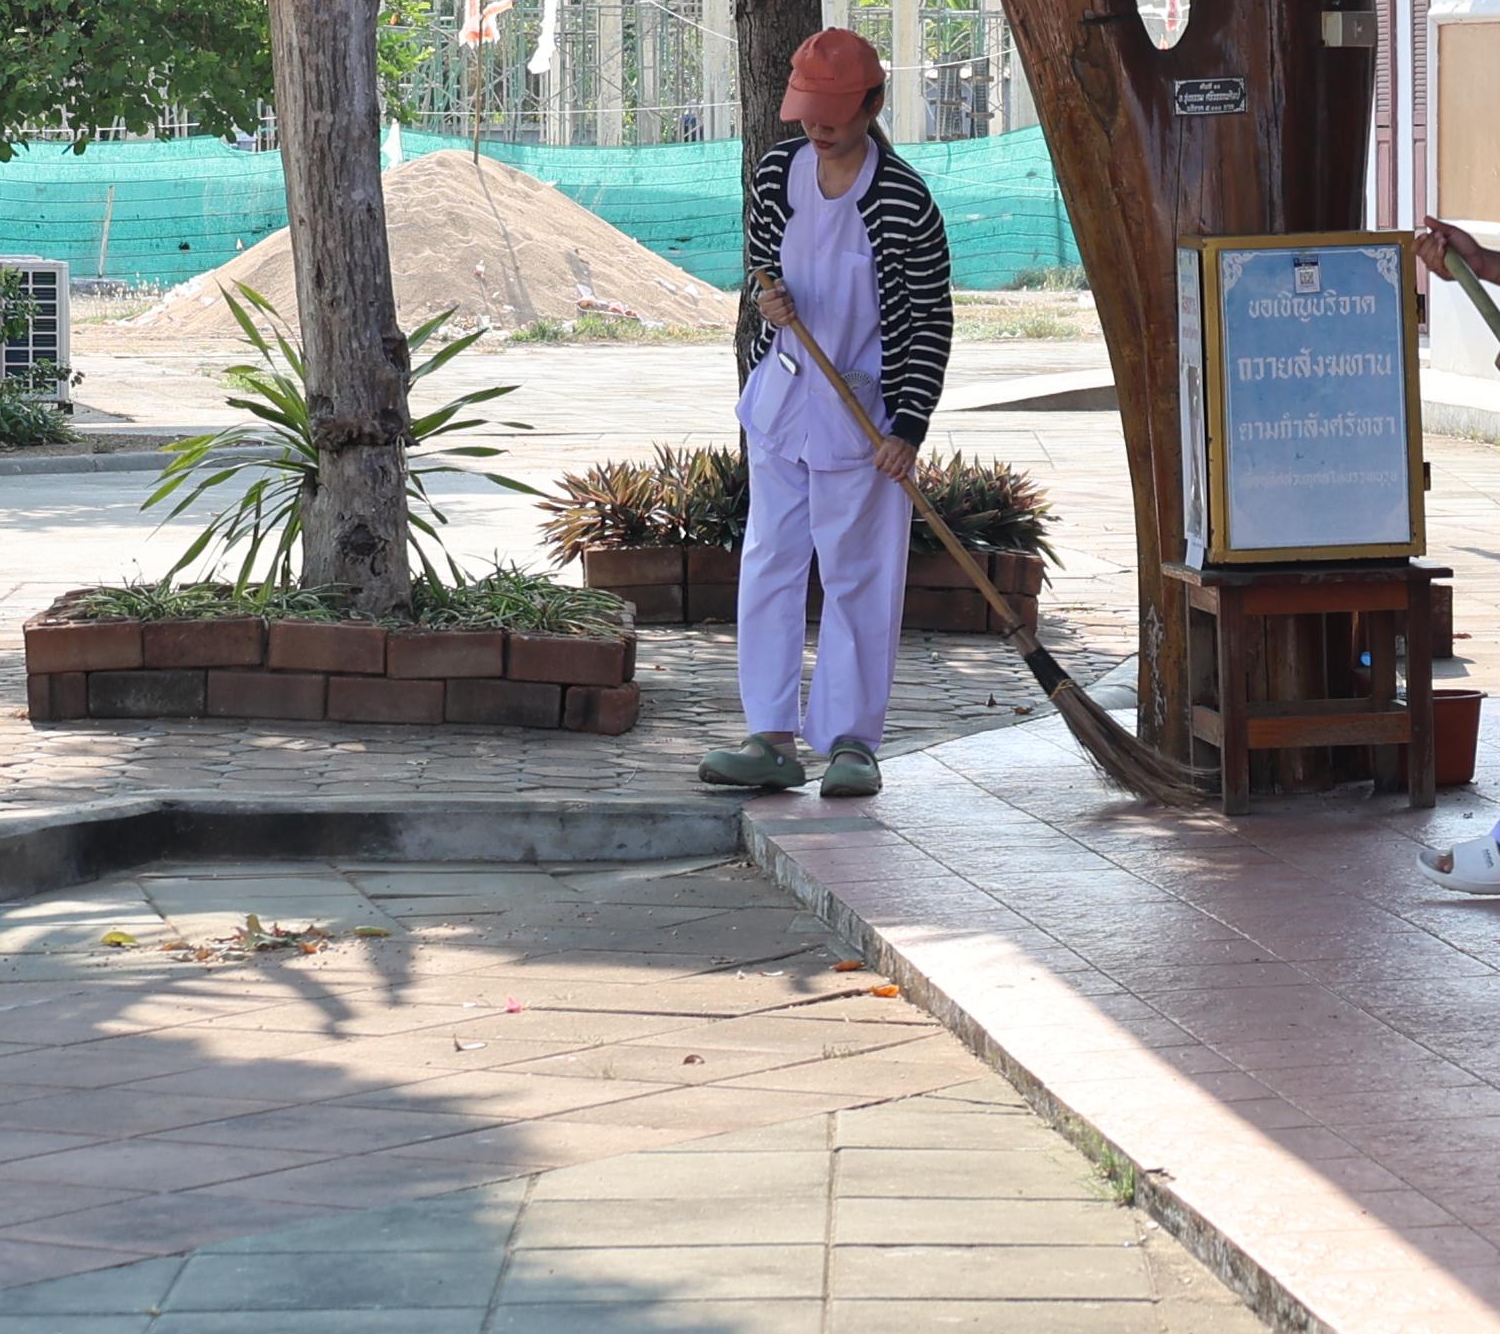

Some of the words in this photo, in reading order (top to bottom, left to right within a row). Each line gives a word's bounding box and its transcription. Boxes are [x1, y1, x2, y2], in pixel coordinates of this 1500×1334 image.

[1248, 289, 1376, 322] ขอเชิญบริจาค
[1237, 348, 1392, 381] ถวายสังฆทาน
[1238, 410, 1396, 441] ตามกำลังศรัทธา
